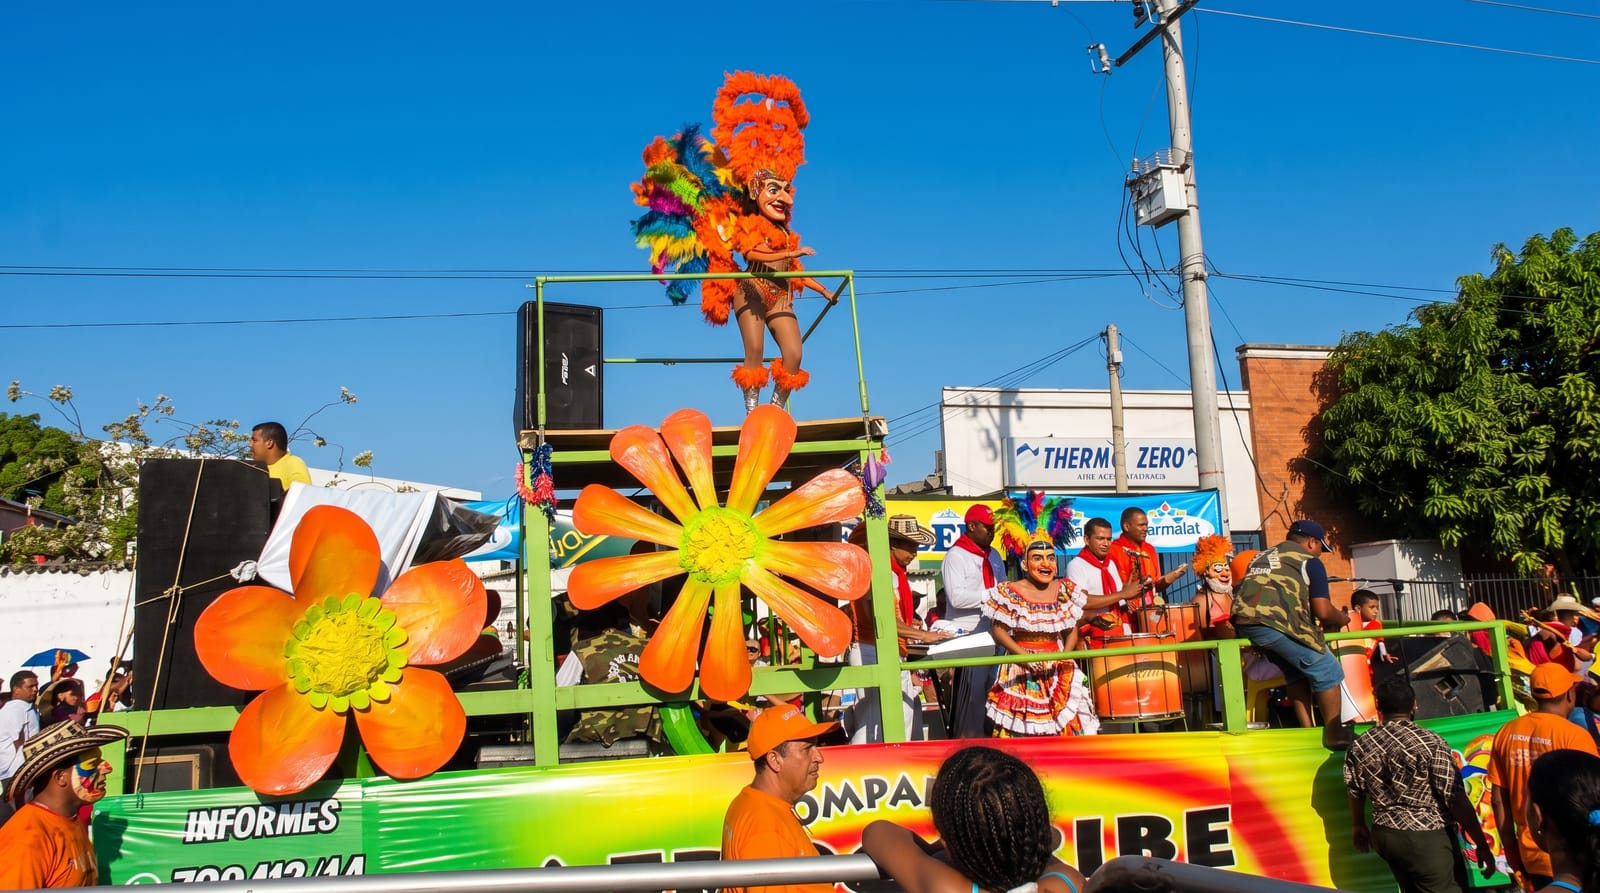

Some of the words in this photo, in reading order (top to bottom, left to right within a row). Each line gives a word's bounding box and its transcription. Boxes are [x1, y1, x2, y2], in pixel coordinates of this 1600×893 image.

[1044, 447, 1116, 469] THERM
[1137, 446, 1185, 469] ZERO
[1147, 521, 1201, 536] armalat
[184, 798, 341, 844] INFORMES
